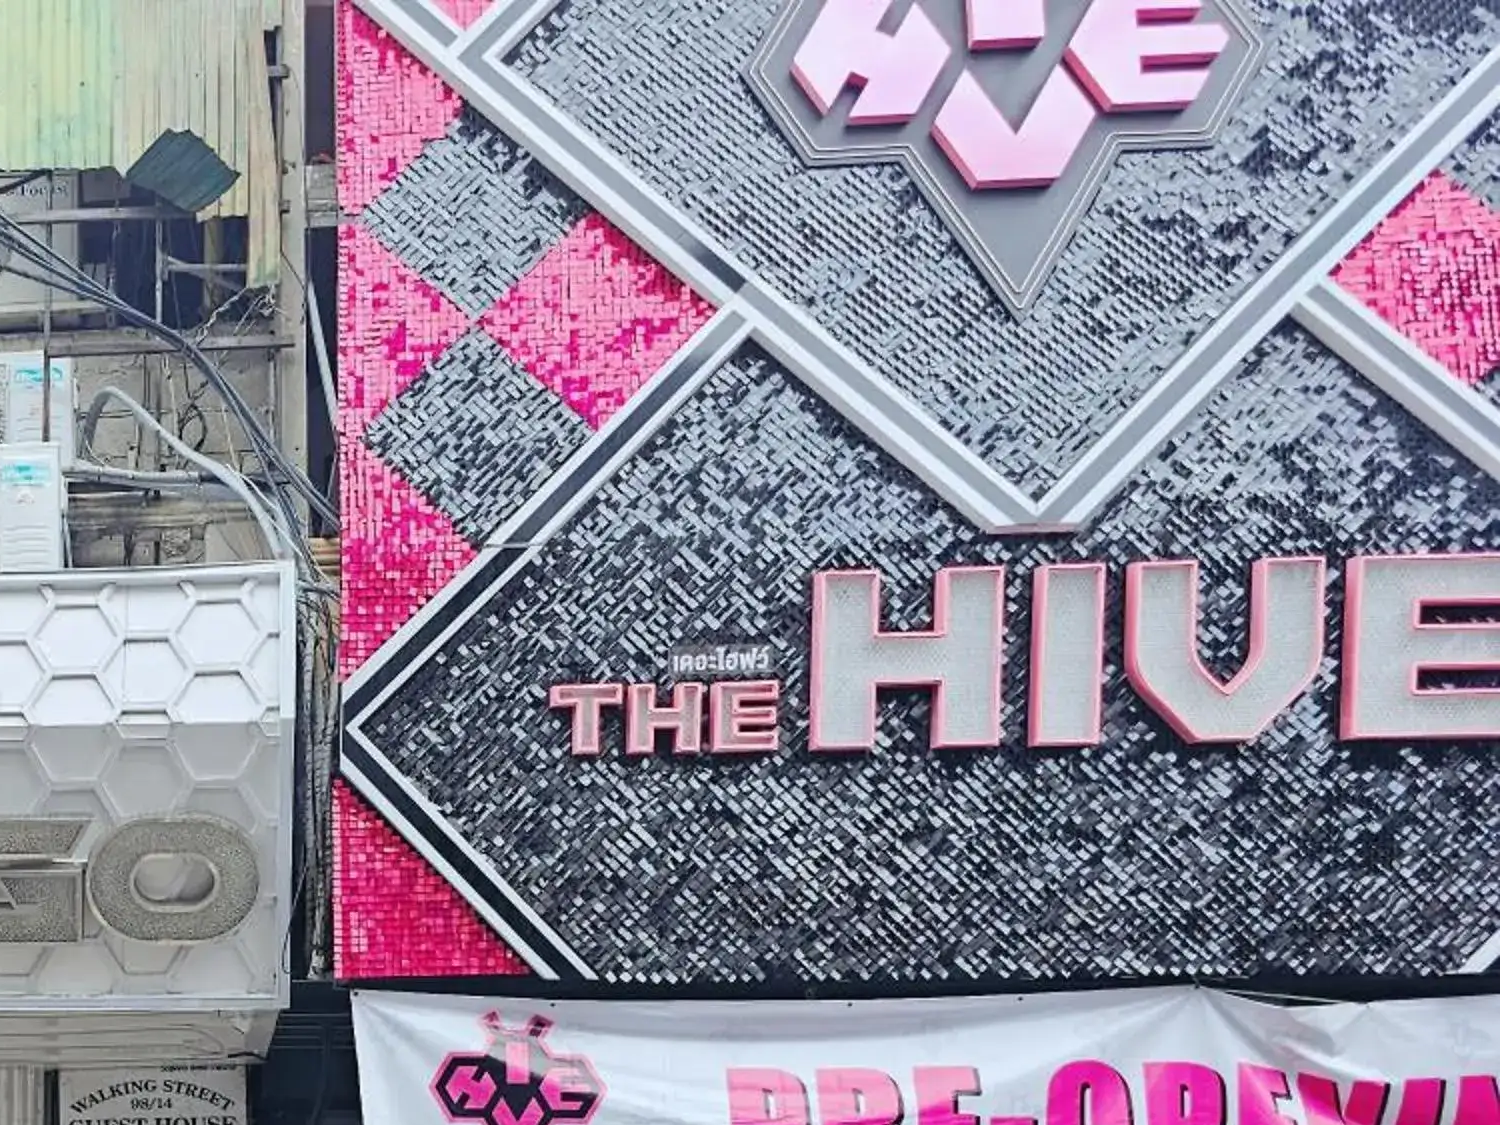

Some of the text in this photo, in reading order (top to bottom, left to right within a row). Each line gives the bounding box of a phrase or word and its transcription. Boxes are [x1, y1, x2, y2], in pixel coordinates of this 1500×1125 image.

[548, 554, 1500, 756] THE HIVE
[69, 1079, 235, 1114] WALKING STREET
